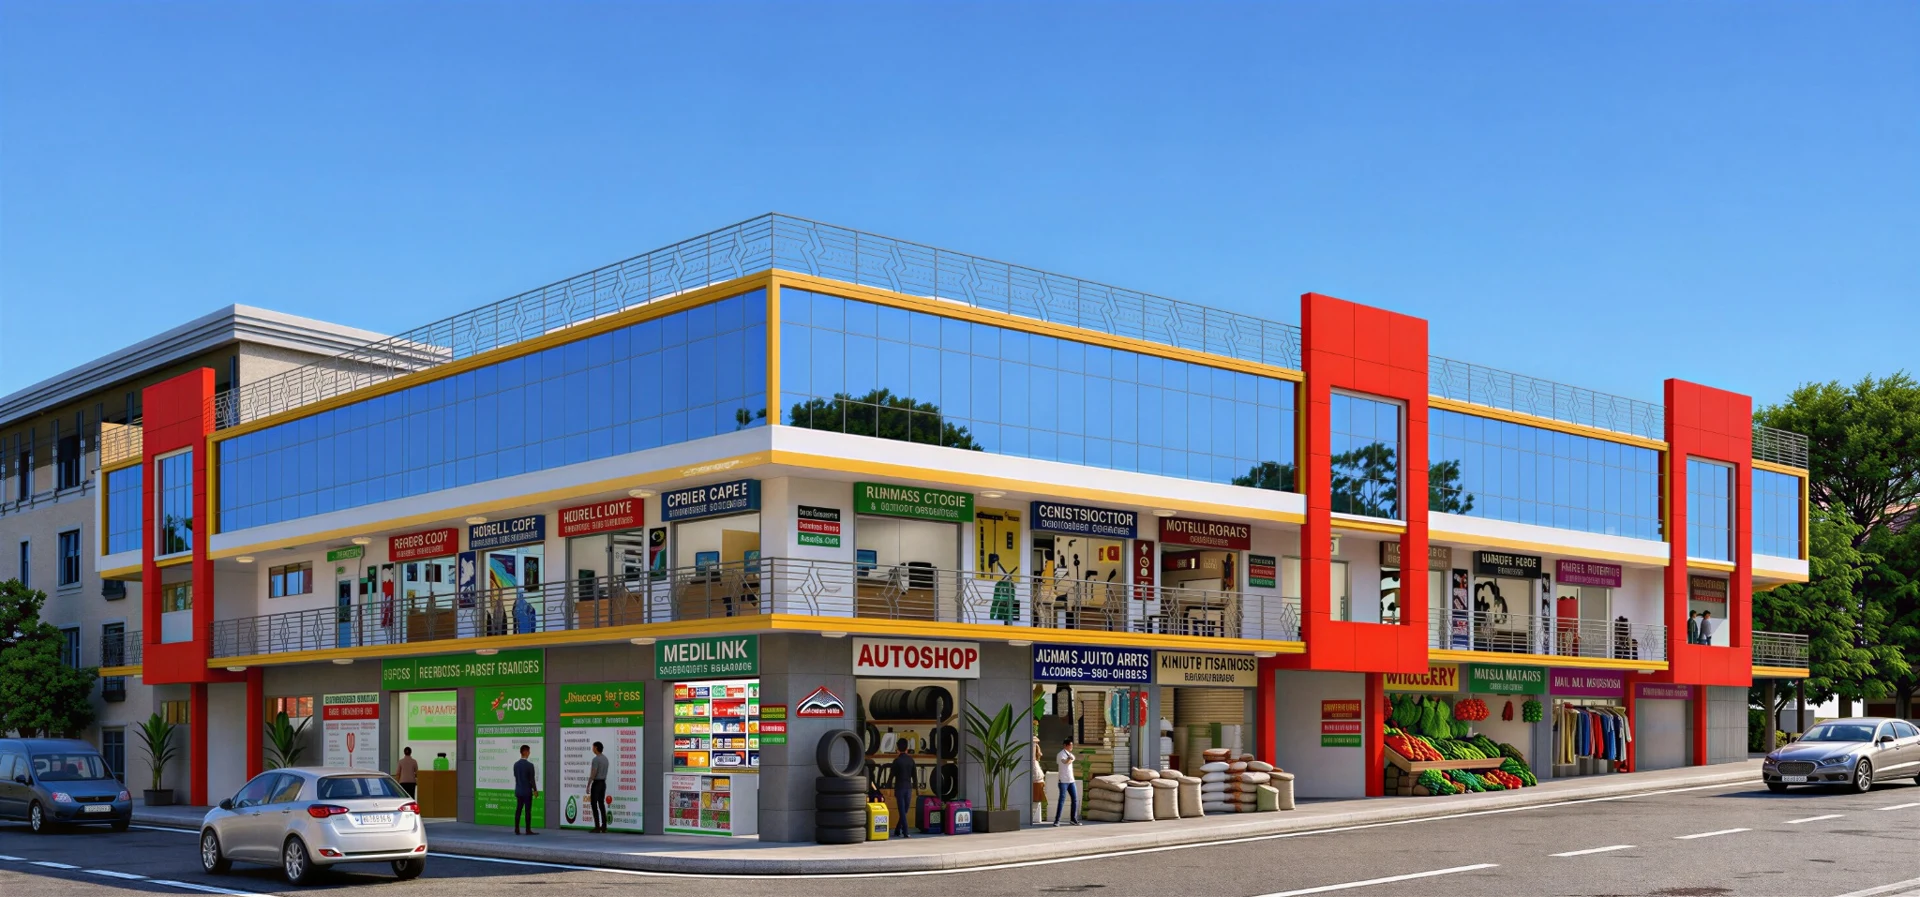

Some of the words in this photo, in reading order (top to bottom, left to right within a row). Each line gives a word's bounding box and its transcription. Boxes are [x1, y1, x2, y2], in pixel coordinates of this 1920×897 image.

[664, 639, 748, 663] MEDILINK
[857, 643, 978, 670] AUTOSHOP
[1117, 652, 1149, 668] ARRTS
